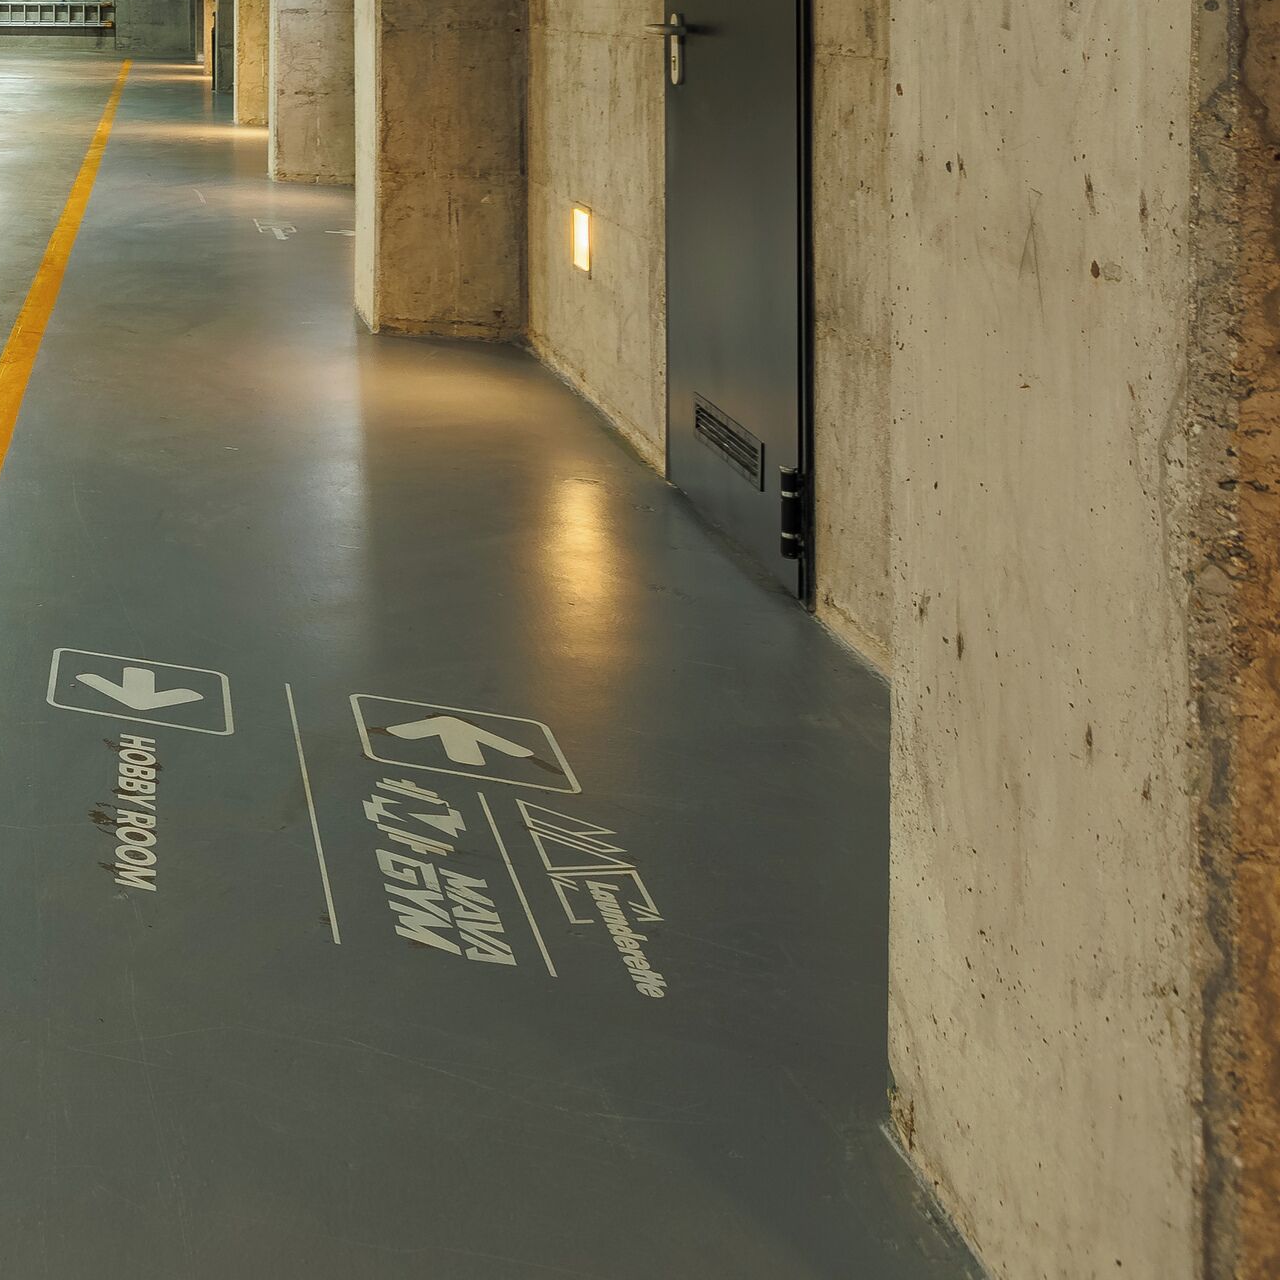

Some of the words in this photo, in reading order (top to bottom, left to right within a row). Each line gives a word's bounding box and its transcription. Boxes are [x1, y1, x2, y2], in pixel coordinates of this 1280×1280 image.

[117, 733, 156, 811] HOBBY
[114, 809, 157, 892] ROOM
[375, 848, 463, 956] GYM
[438, 867, 518, 966] MAVA
[584, 879, 668, 999] Launderette
